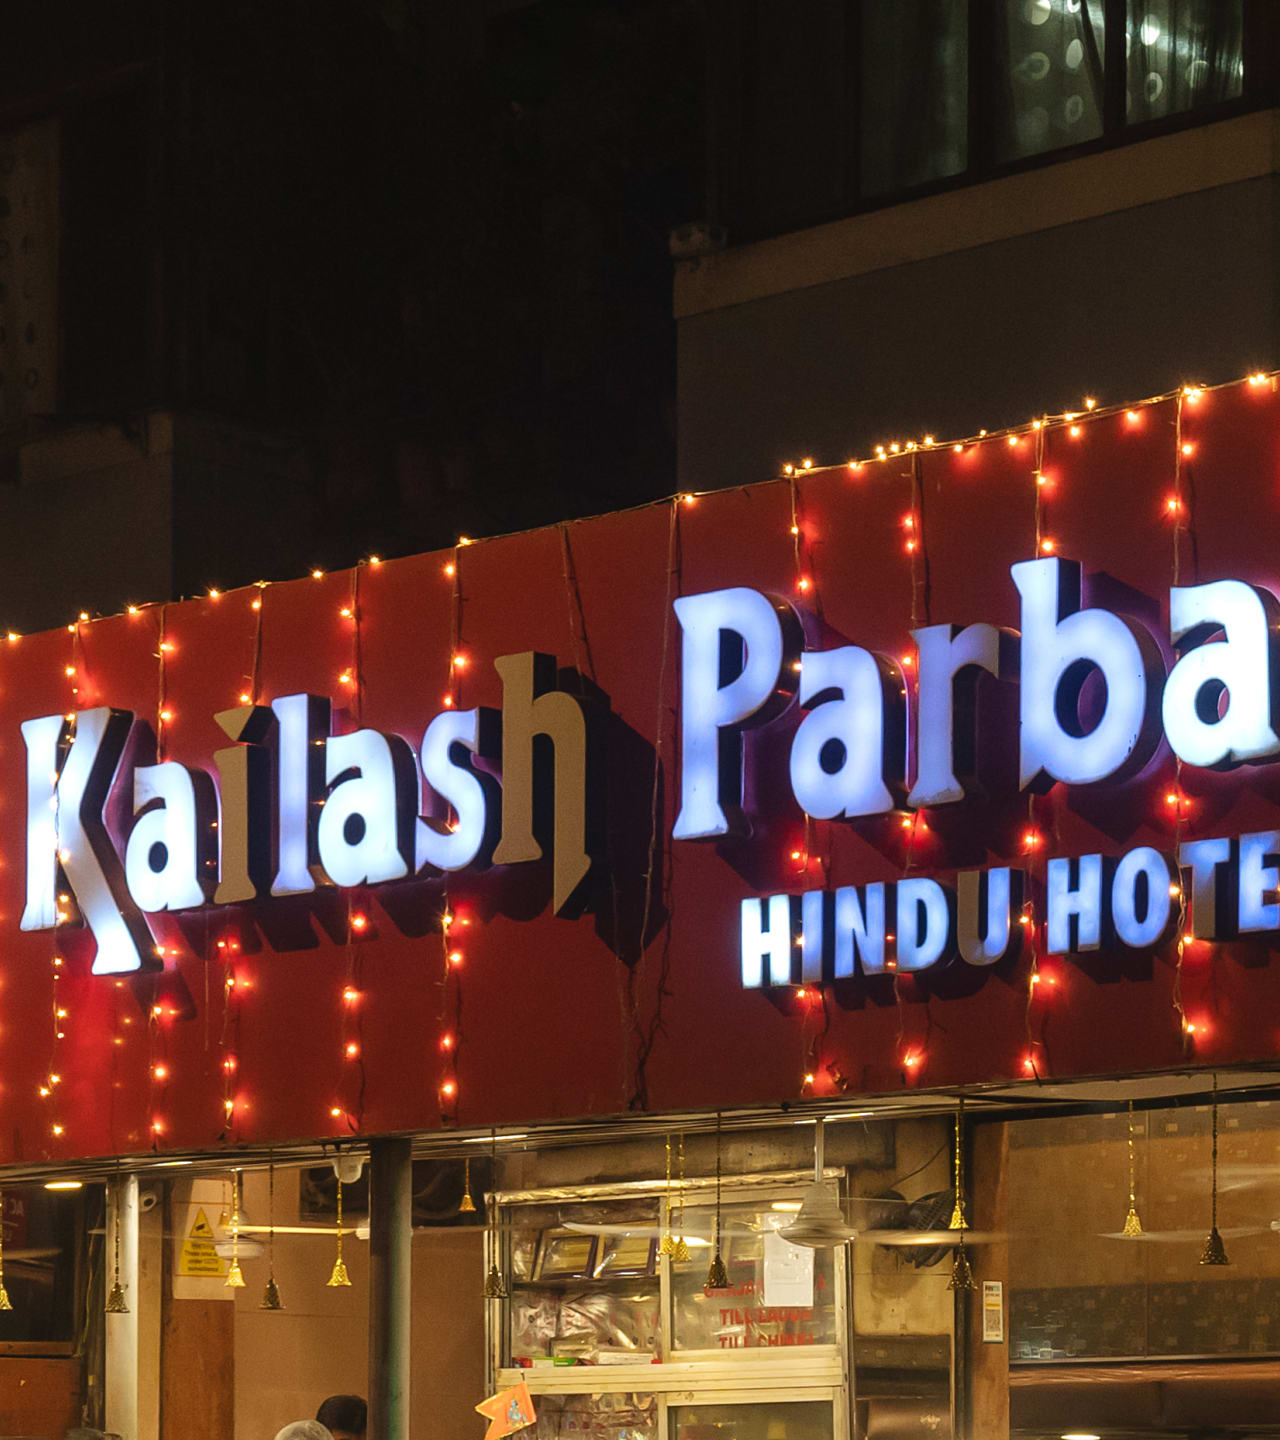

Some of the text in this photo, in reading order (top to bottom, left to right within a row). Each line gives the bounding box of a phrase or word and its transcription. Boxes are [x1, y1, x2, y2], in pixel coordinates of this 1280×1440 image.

[19, 650, 591, 975] Kailash
[740, 864, 1026, 990] HINDU
[719, 1308, 754, 1325] TILL
